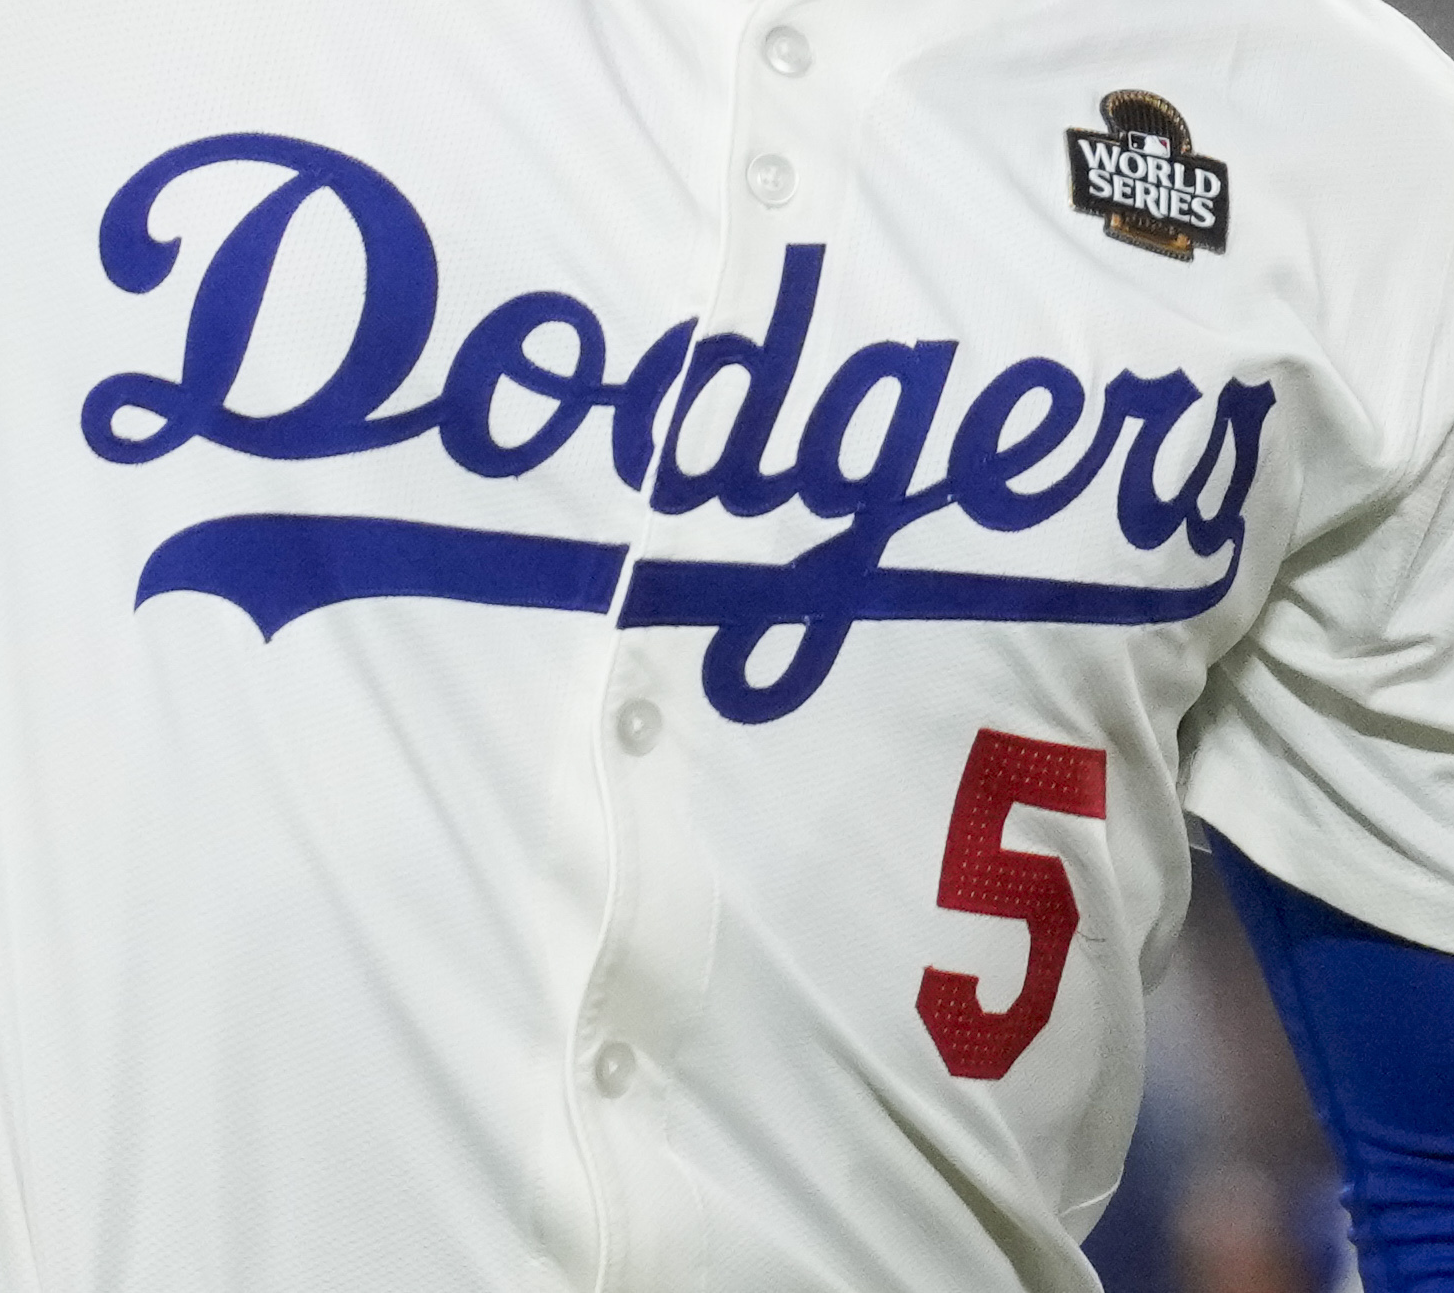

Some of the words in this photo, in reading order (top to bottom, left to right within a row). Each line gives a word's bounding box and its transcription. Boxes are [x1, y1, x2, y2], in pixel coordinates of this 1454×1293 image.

[1078, 139, 1221, 199] WORLD
[1088, 168, 1216, 229] SERIES
[80, 131, 1276, 724] Dodgers
[915, 728, 1106, 1080] 5
